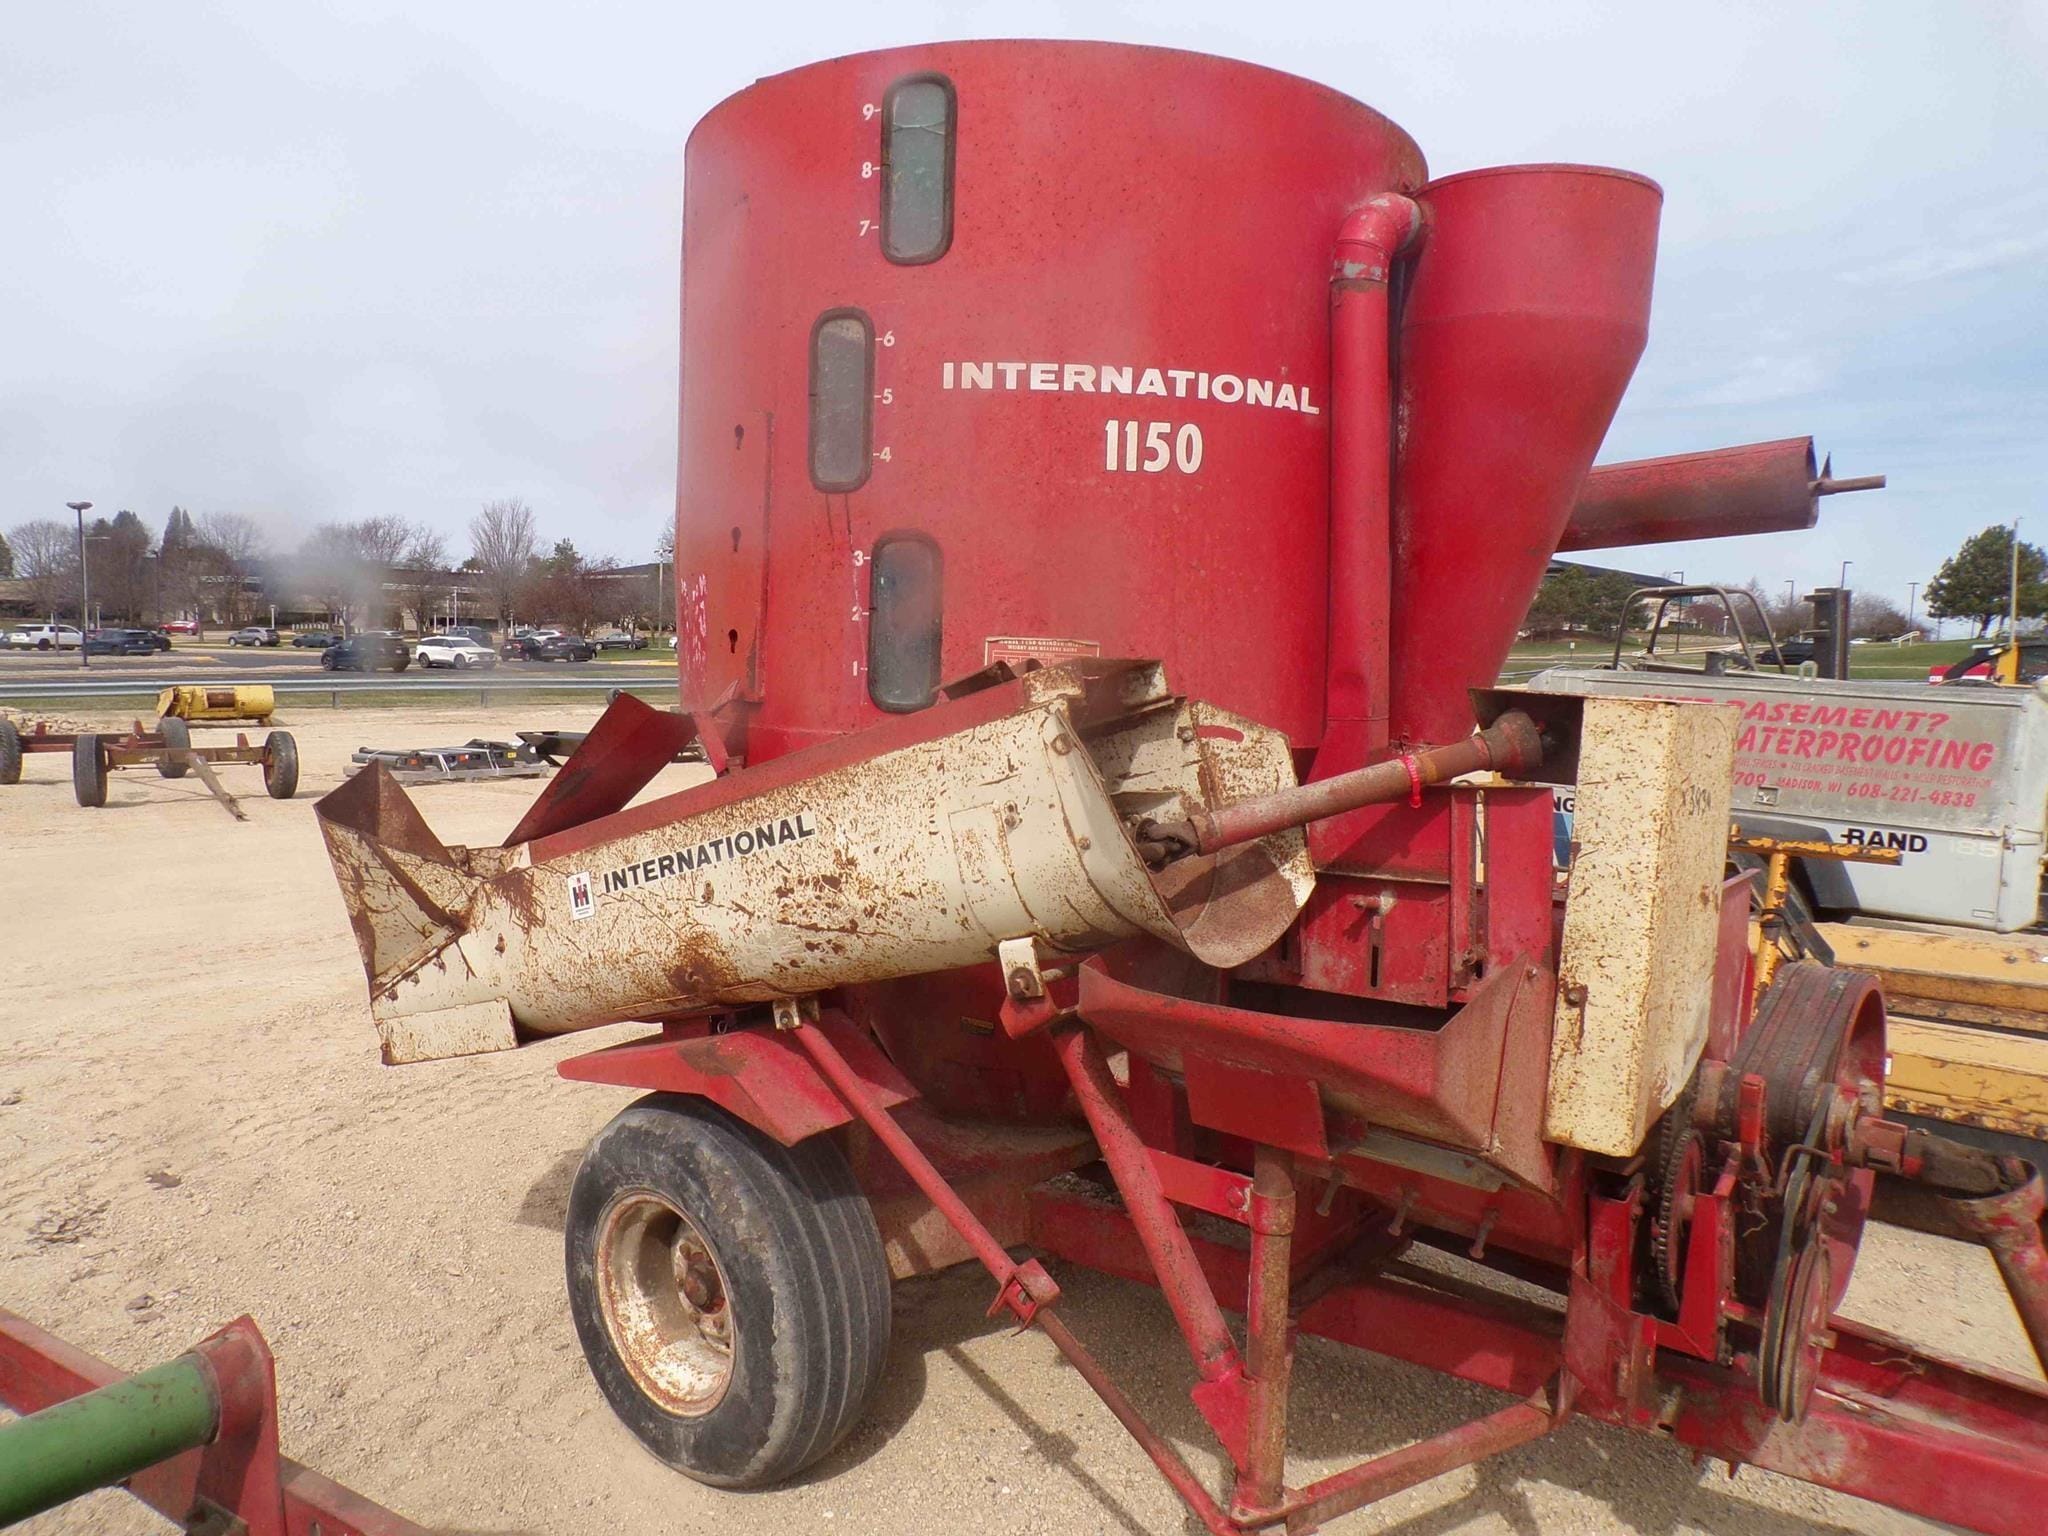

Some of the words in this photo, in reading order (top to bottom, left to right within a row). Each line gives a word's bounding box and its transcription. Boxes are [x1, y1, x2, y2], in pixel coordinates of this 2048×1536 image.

[862, 103, 874, 120] 9
[861, 161, 872, 178] 8
[860, 219, 871, 236] 7
[883, 330, 895, 347] 6
[882, 388, 893, 404] 5
[942, 361, 1320, 415] INTERNATIONAL
[880, 446, 892, 462] 4
[1104, 419, 1203, 474] 1150
[853, 550, 864, 567] 3
[851, 605, 862, 621] 2
[1736, 724, 1995, 772] ATERPROOFING
[1847, 782, 1977, 808] 608-221-4838
[603, 815, 815, 894] INTERNATIONAL
